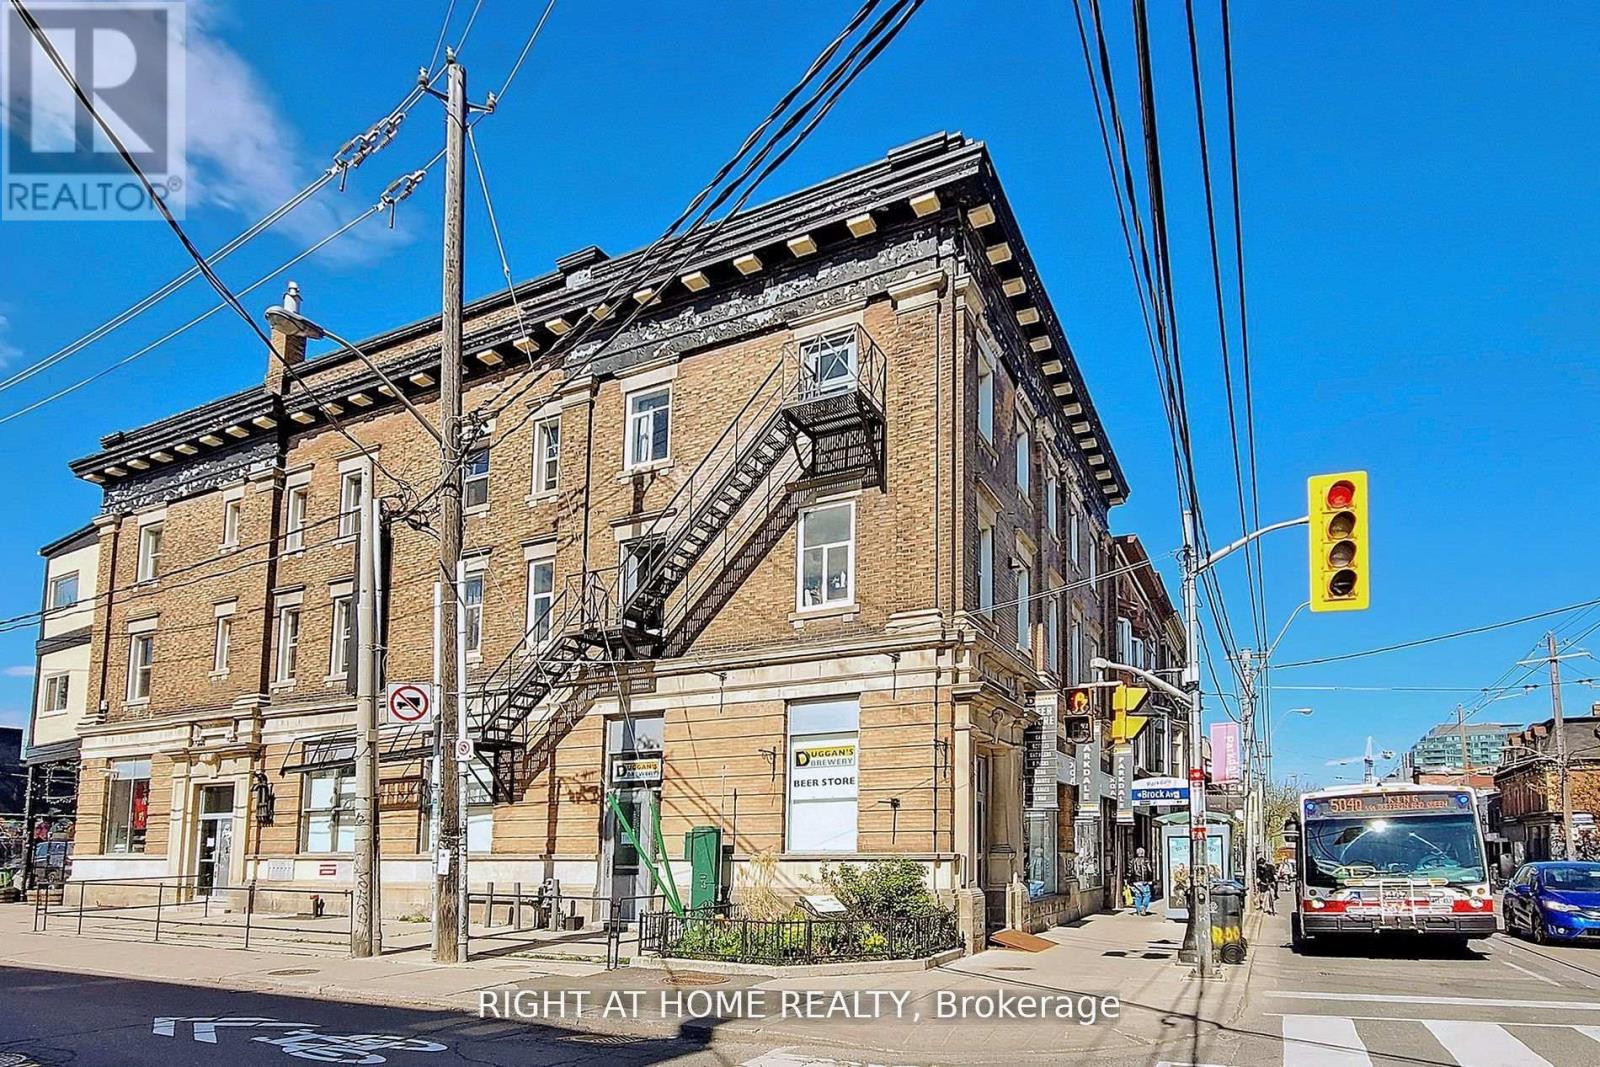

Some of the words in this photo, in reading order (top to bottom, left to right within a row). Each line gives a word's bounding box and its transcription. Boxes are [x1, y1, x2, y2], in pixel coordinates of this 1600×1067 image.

[795, 748, 854, 767] DUGGAN'S
[810, 758, 853, 766] BREWERY
[1083, 745, 1092, 800] ARKDALE
[793, 778, 819, 788] BEER
[821, 776, 856, 786] STORE
[1141, 788, 1165, 799] Brock
[1388, 794, 1418, 803] KING
